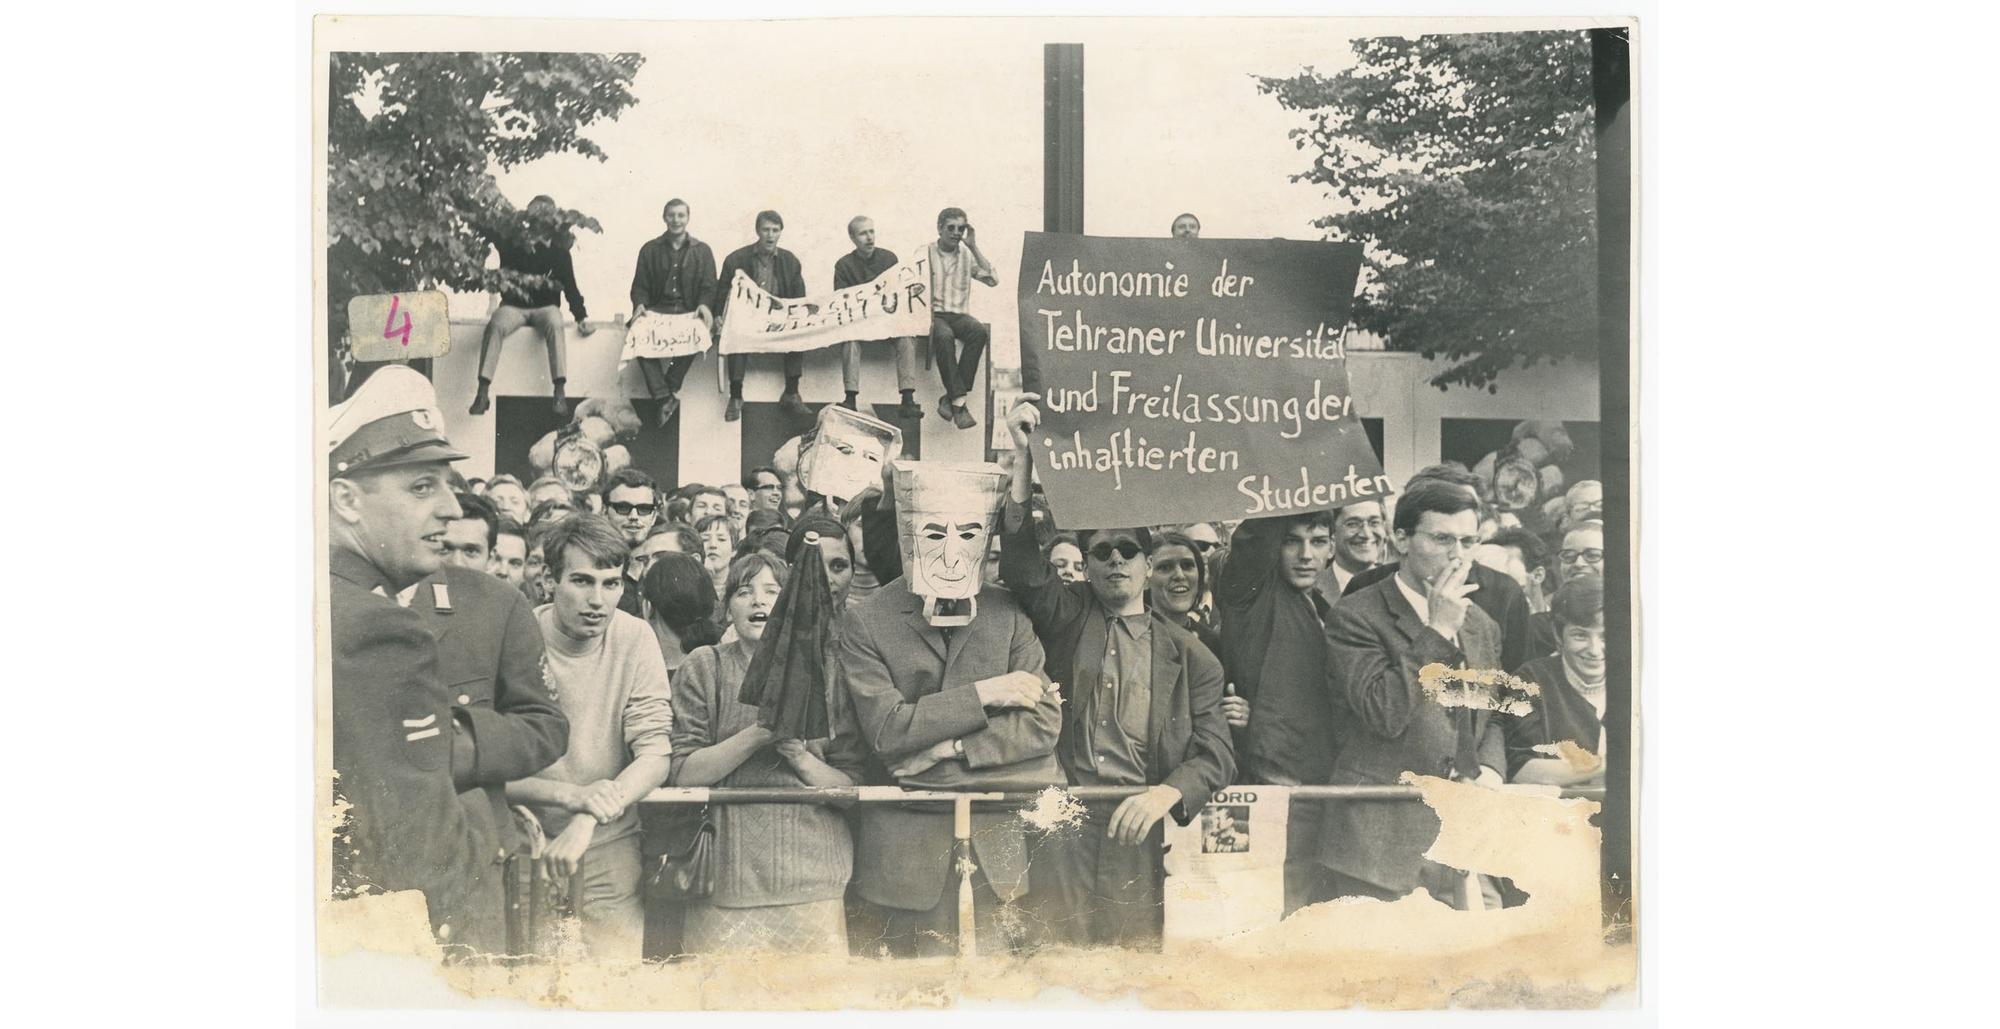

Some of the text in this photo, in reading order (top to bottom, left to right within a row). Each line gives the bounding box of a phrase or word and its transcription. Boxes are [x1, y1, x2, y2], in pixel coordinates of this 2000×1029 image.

[1036, 258, 1254, 298] Autonomie der
[384, 295, 413, 346] 4
[1038, 308, 1347, 360] Tehraner Universität
[1047, 370, 1098, 413] und
[1110, 371, 1302, 439] Freilassung
[1044, 428, 1239, 490] inhaftierten
[1237, 464, 1395, 514] Studenten
[1210, 792, 1258, 803] ORD
